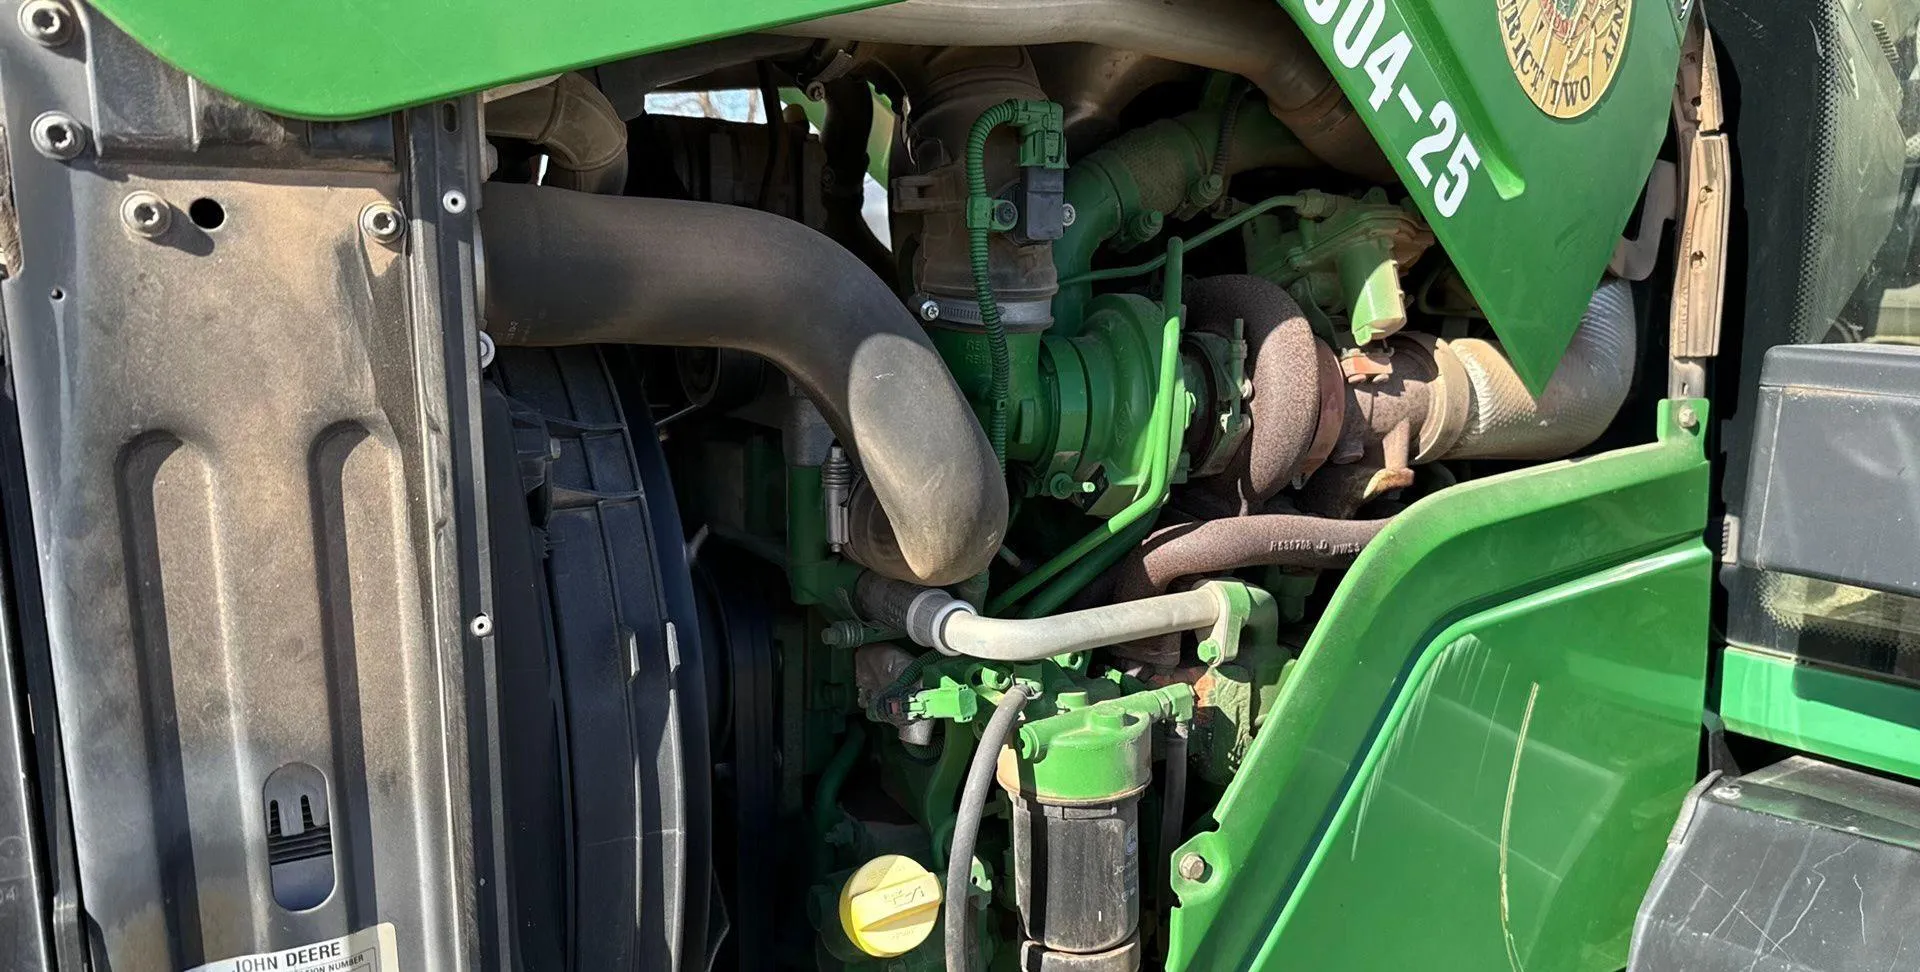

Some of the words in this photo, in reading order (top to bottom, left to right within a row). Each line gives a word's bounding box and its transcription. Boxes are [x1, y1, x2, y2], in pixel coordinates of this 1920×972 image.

[1500, 0, 1545, 92] RICT
[1549, 75, 1591, 107] TWO
[232, 956, 278, 972] JOHN
[286, 942, 340, 967] DEERE
[328, 954, 364, 972] NUMBER
